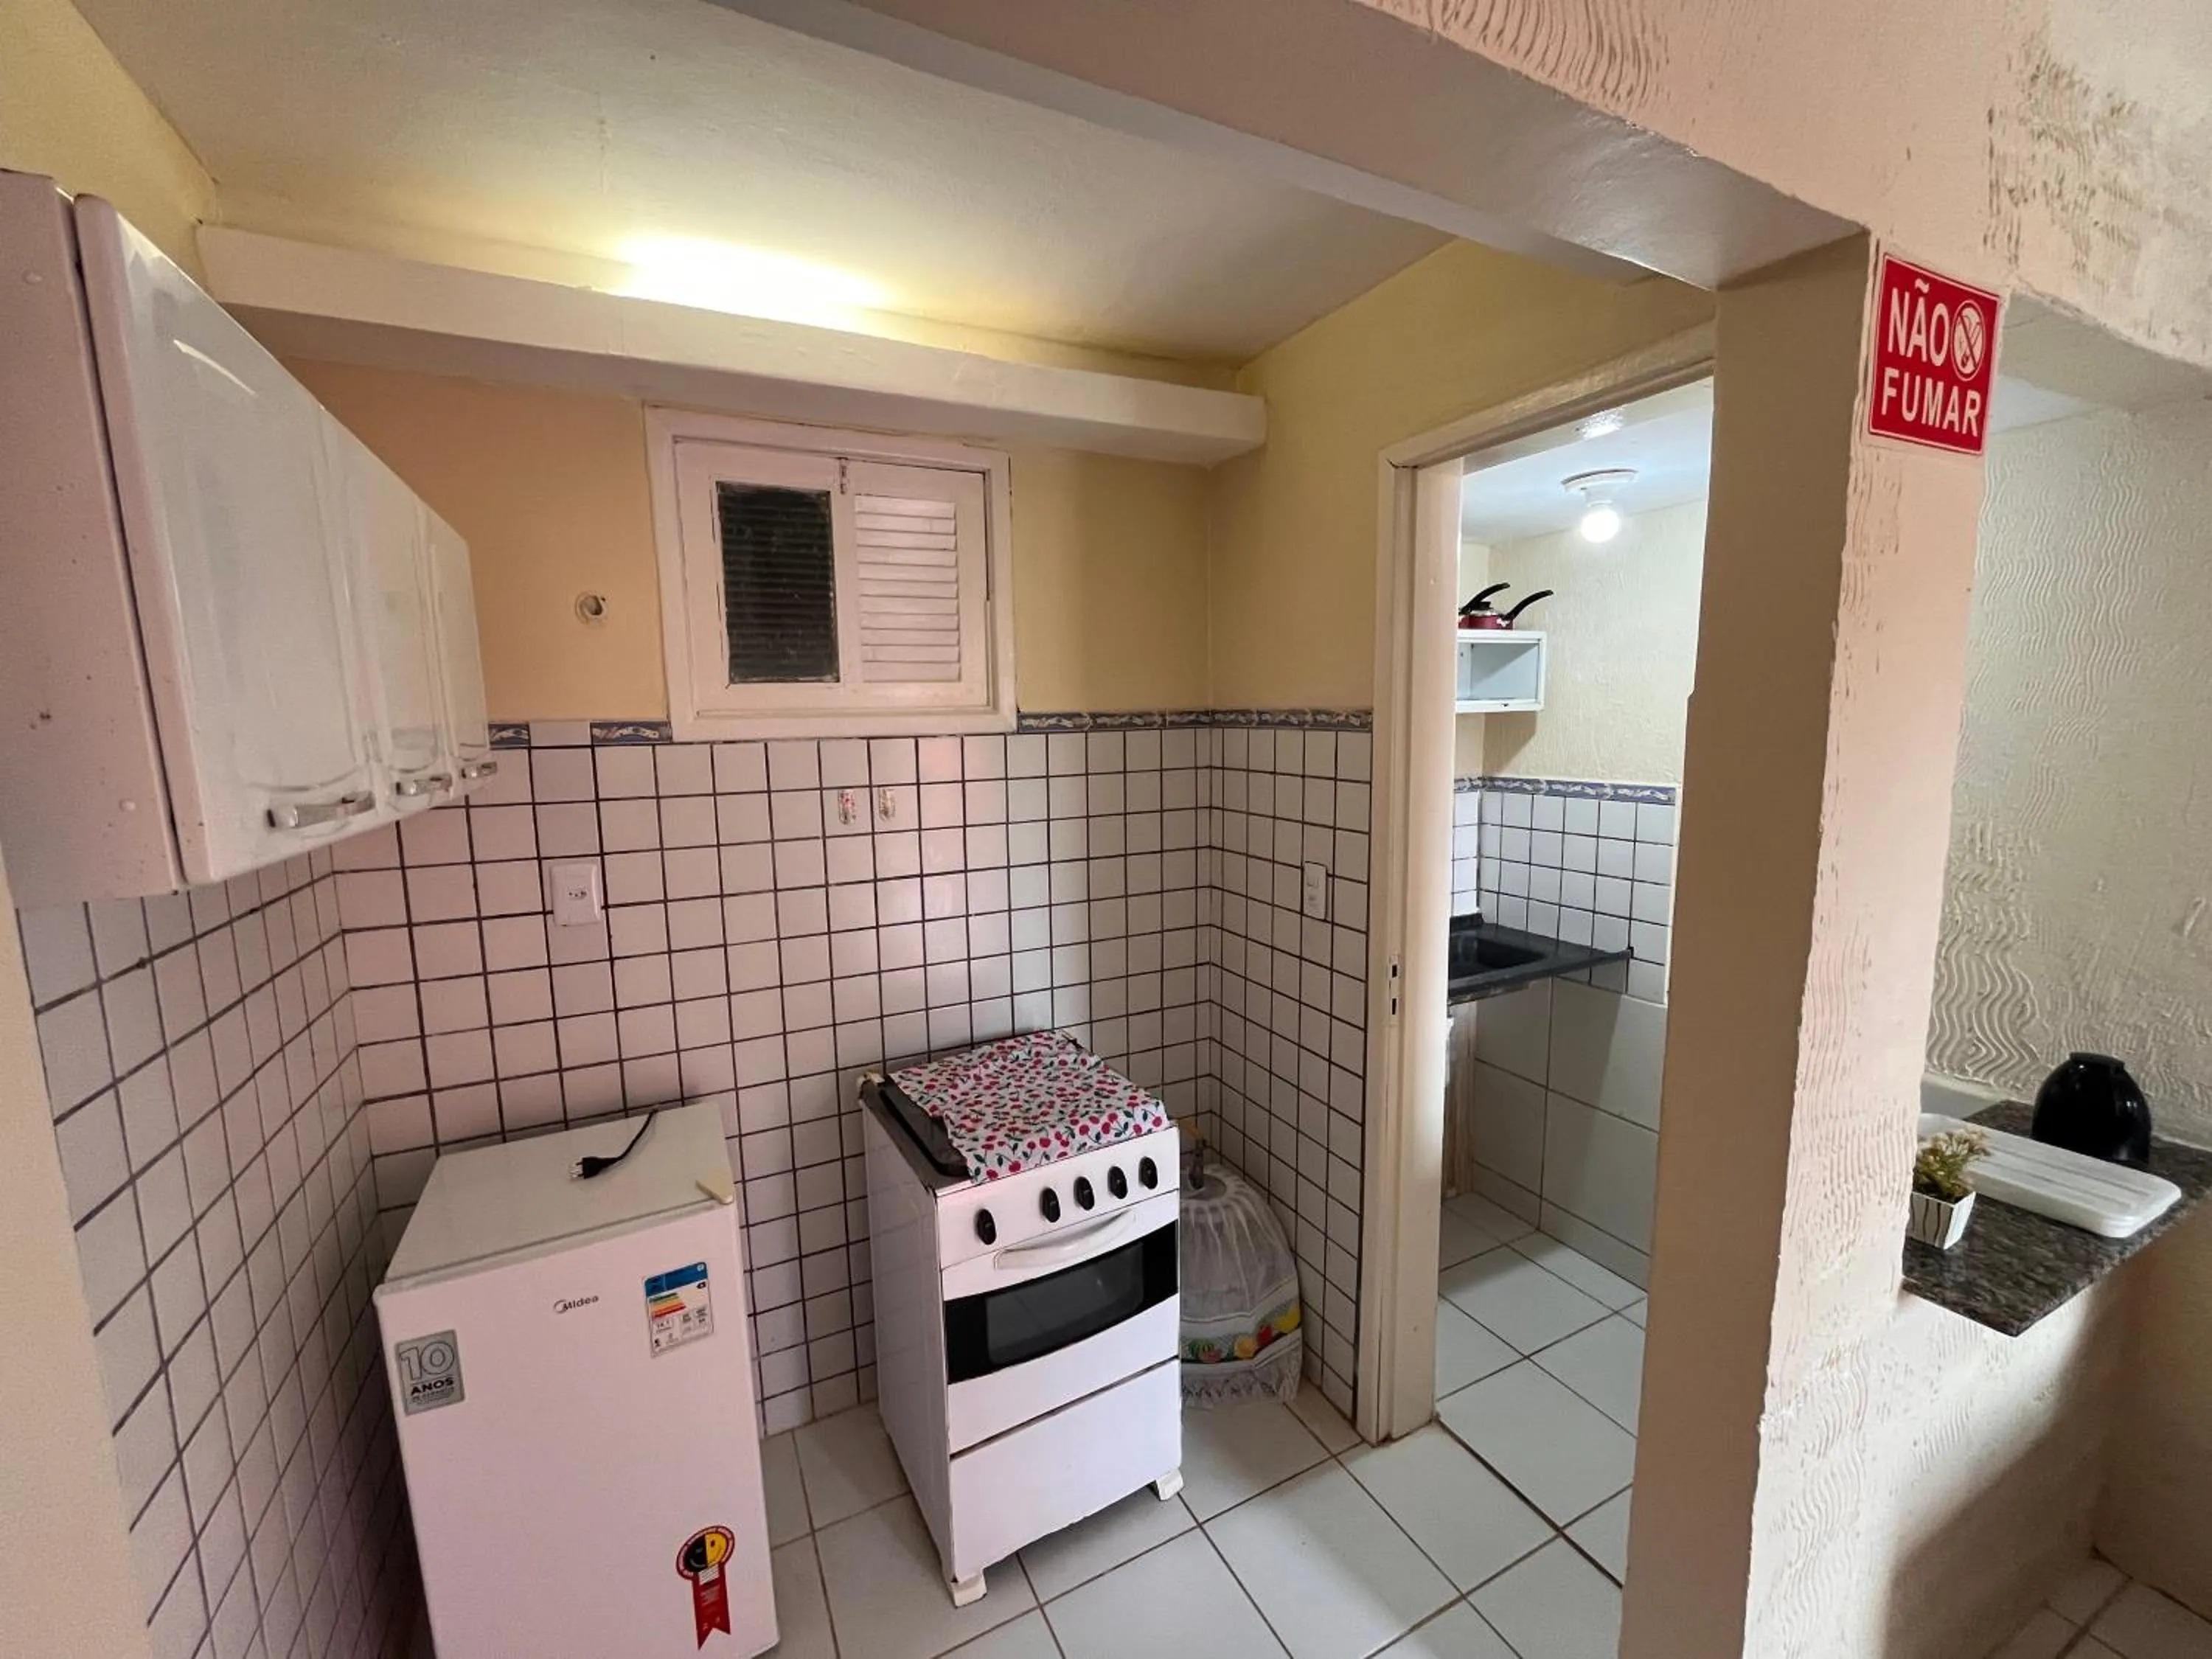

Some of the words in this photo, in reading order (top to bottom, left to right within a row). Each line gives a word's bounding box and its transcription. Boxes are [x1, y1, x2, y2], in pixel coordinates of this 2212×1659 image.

[1888, 278, 1950, 367] NÃO
[1881, 366, 1981, 437] FUMAR
[554, 1295, 599, 1313] Midea
[400, 1340, 455, 1381] 10
[411, 1377, 453, 1396] ANOS
